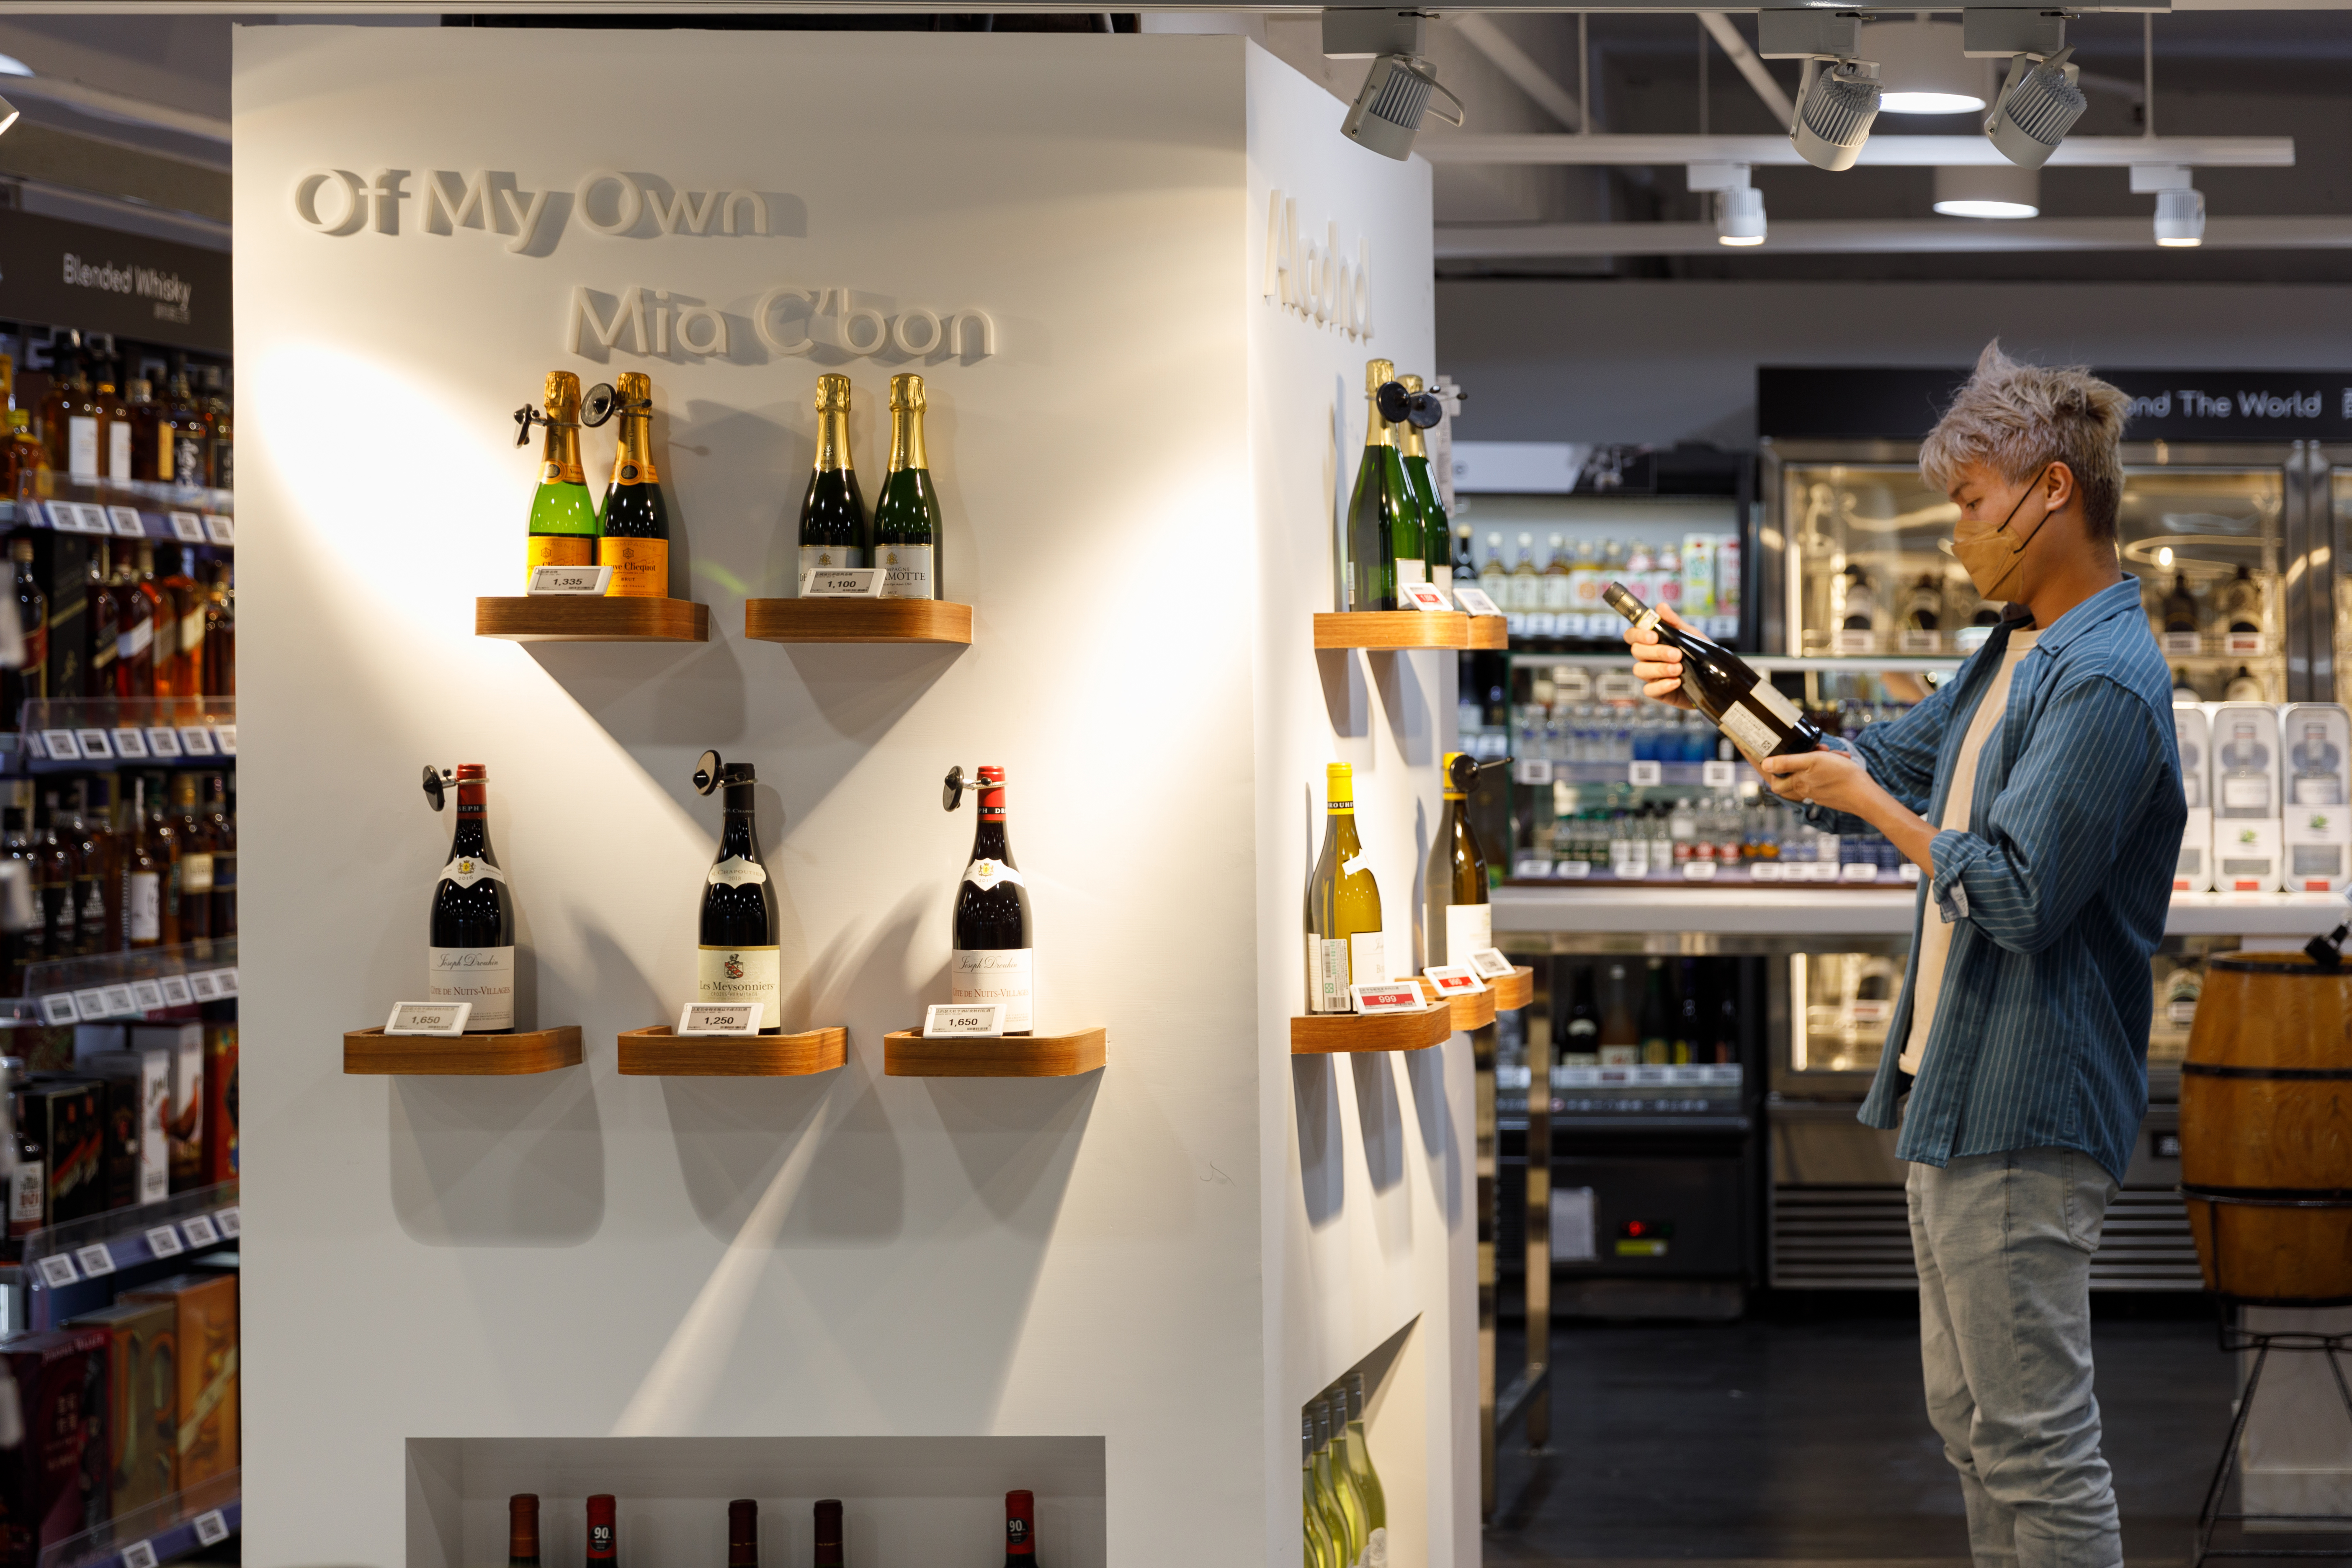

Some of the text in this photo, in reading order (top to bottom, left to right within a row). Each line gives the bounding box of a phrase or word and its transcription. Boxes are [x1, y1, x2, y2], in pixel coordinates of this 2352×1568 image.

[295, 168, 769, 252] Of My Own
[1264, 189, 1375, 338] Alcohol
[63, 252, 191, 311] Blended Whisky
[567, 286, 995, 355] Mia C'bon
[2177, 390, 2232, 418] The
[2237, 390, 2322, 418] World
[603, 541, 657, 552] CHAMPAGNE
[624, 562, 656, 572] Clicquot
[437, 953, 499, 970] Joseph Drouhin
[959, 955, 1018, 972] Joseph Drouhin
[453, 986, 510, 996] NUITS-VILLAGES
[700, 981, 774, 994] Les Meysonniers
[974, 989, 1029, 997] NUITS-VILLAGES
[412, 1016, 441, 1025] 1,650
[704, 1017, 734, 1025] 1,250
[949, 1018, 978, 1027] 1,650
[1009, 1520, 1023, 1532] 90
[594, 1527, 609, 1539] 90
